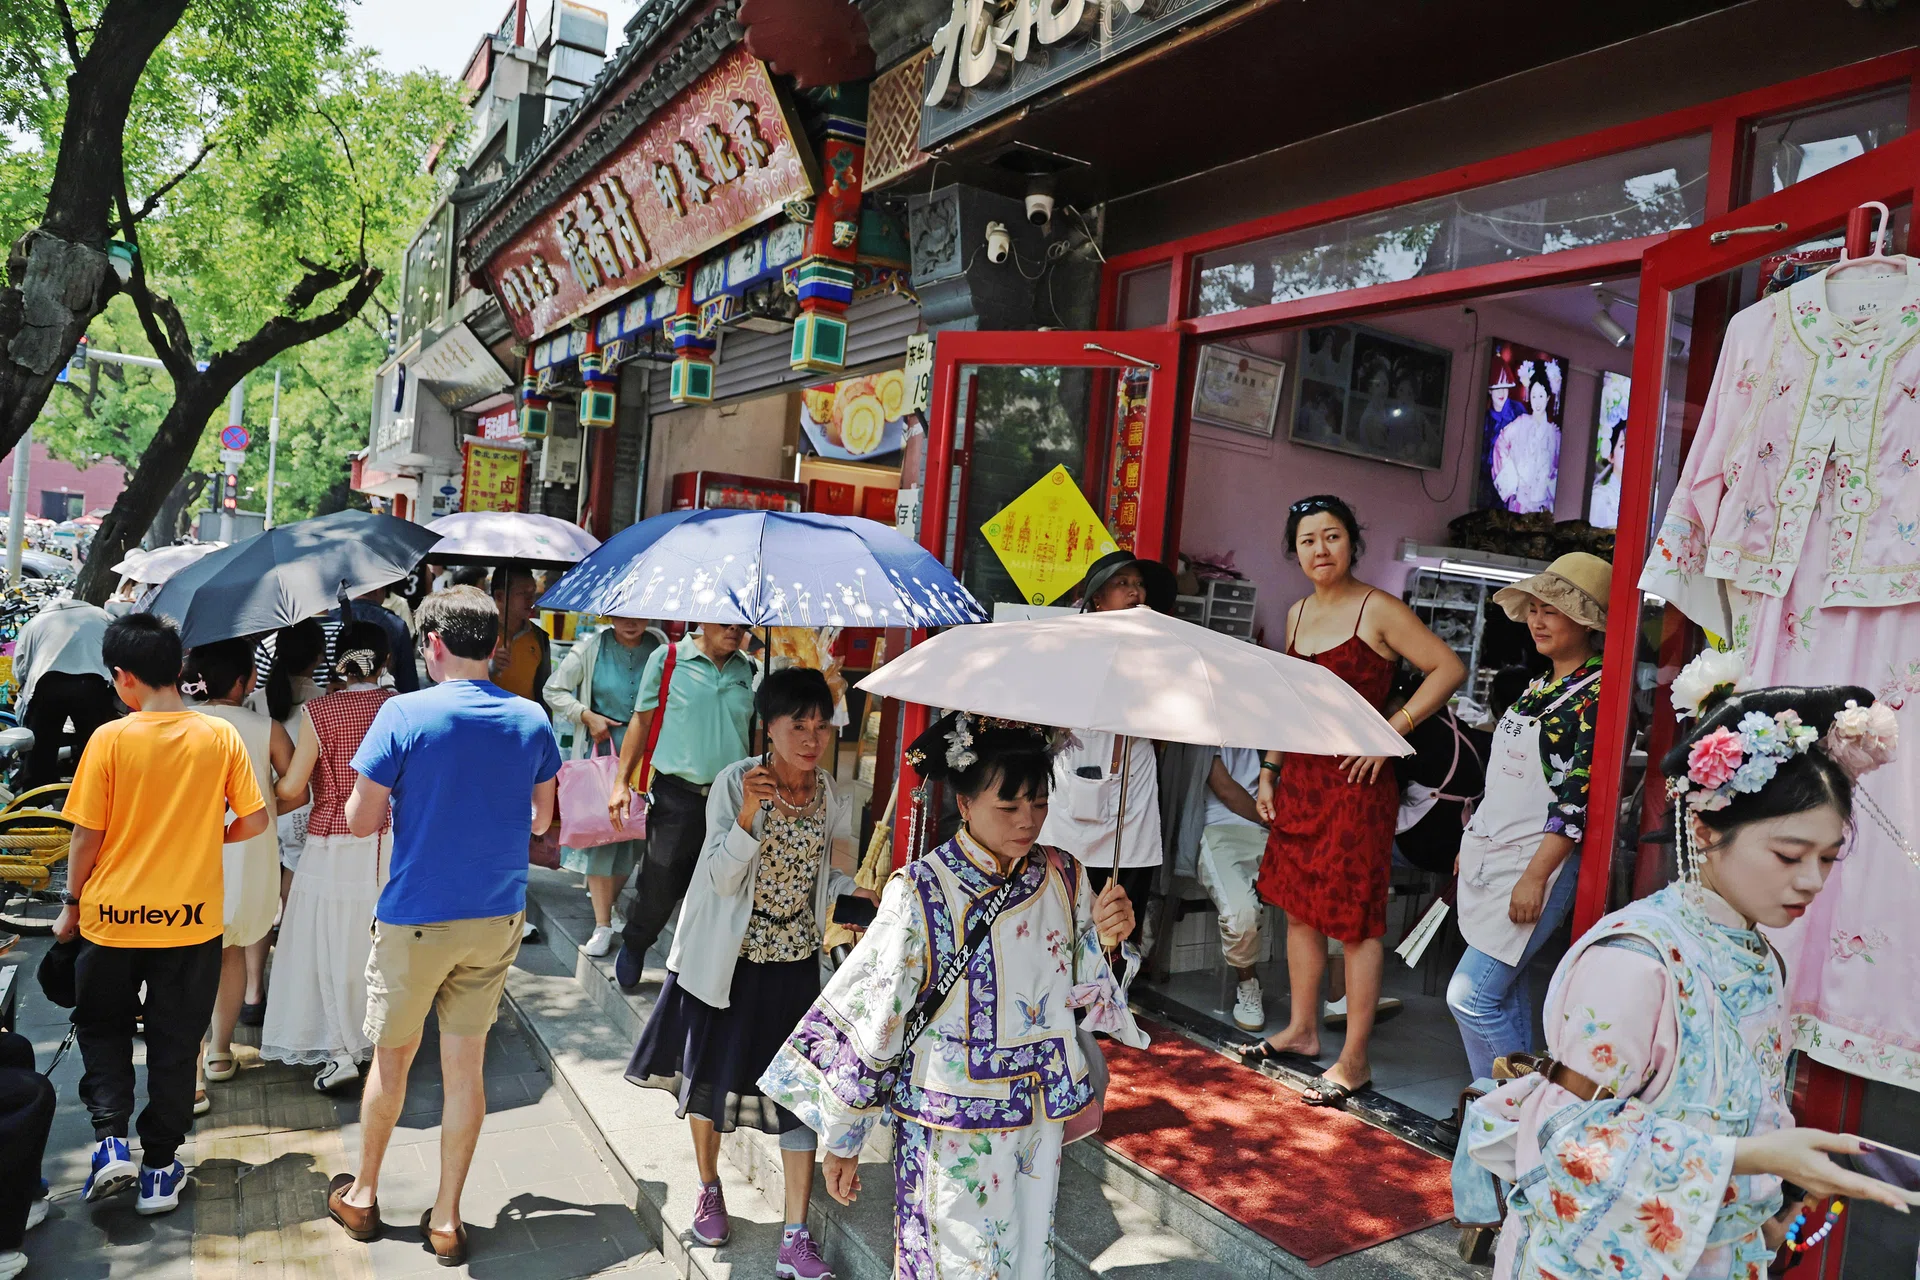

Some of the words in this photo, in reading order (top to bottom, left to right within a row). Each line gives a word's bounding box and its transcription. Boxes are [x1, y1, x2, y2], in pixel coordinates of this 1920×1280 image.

[556, 175, 652, 294] 稻香村
[652, 98, 775, 217] 印象北京
[913, 372, 928, 405] 19
[98, 903, 181, 926] Hurley
